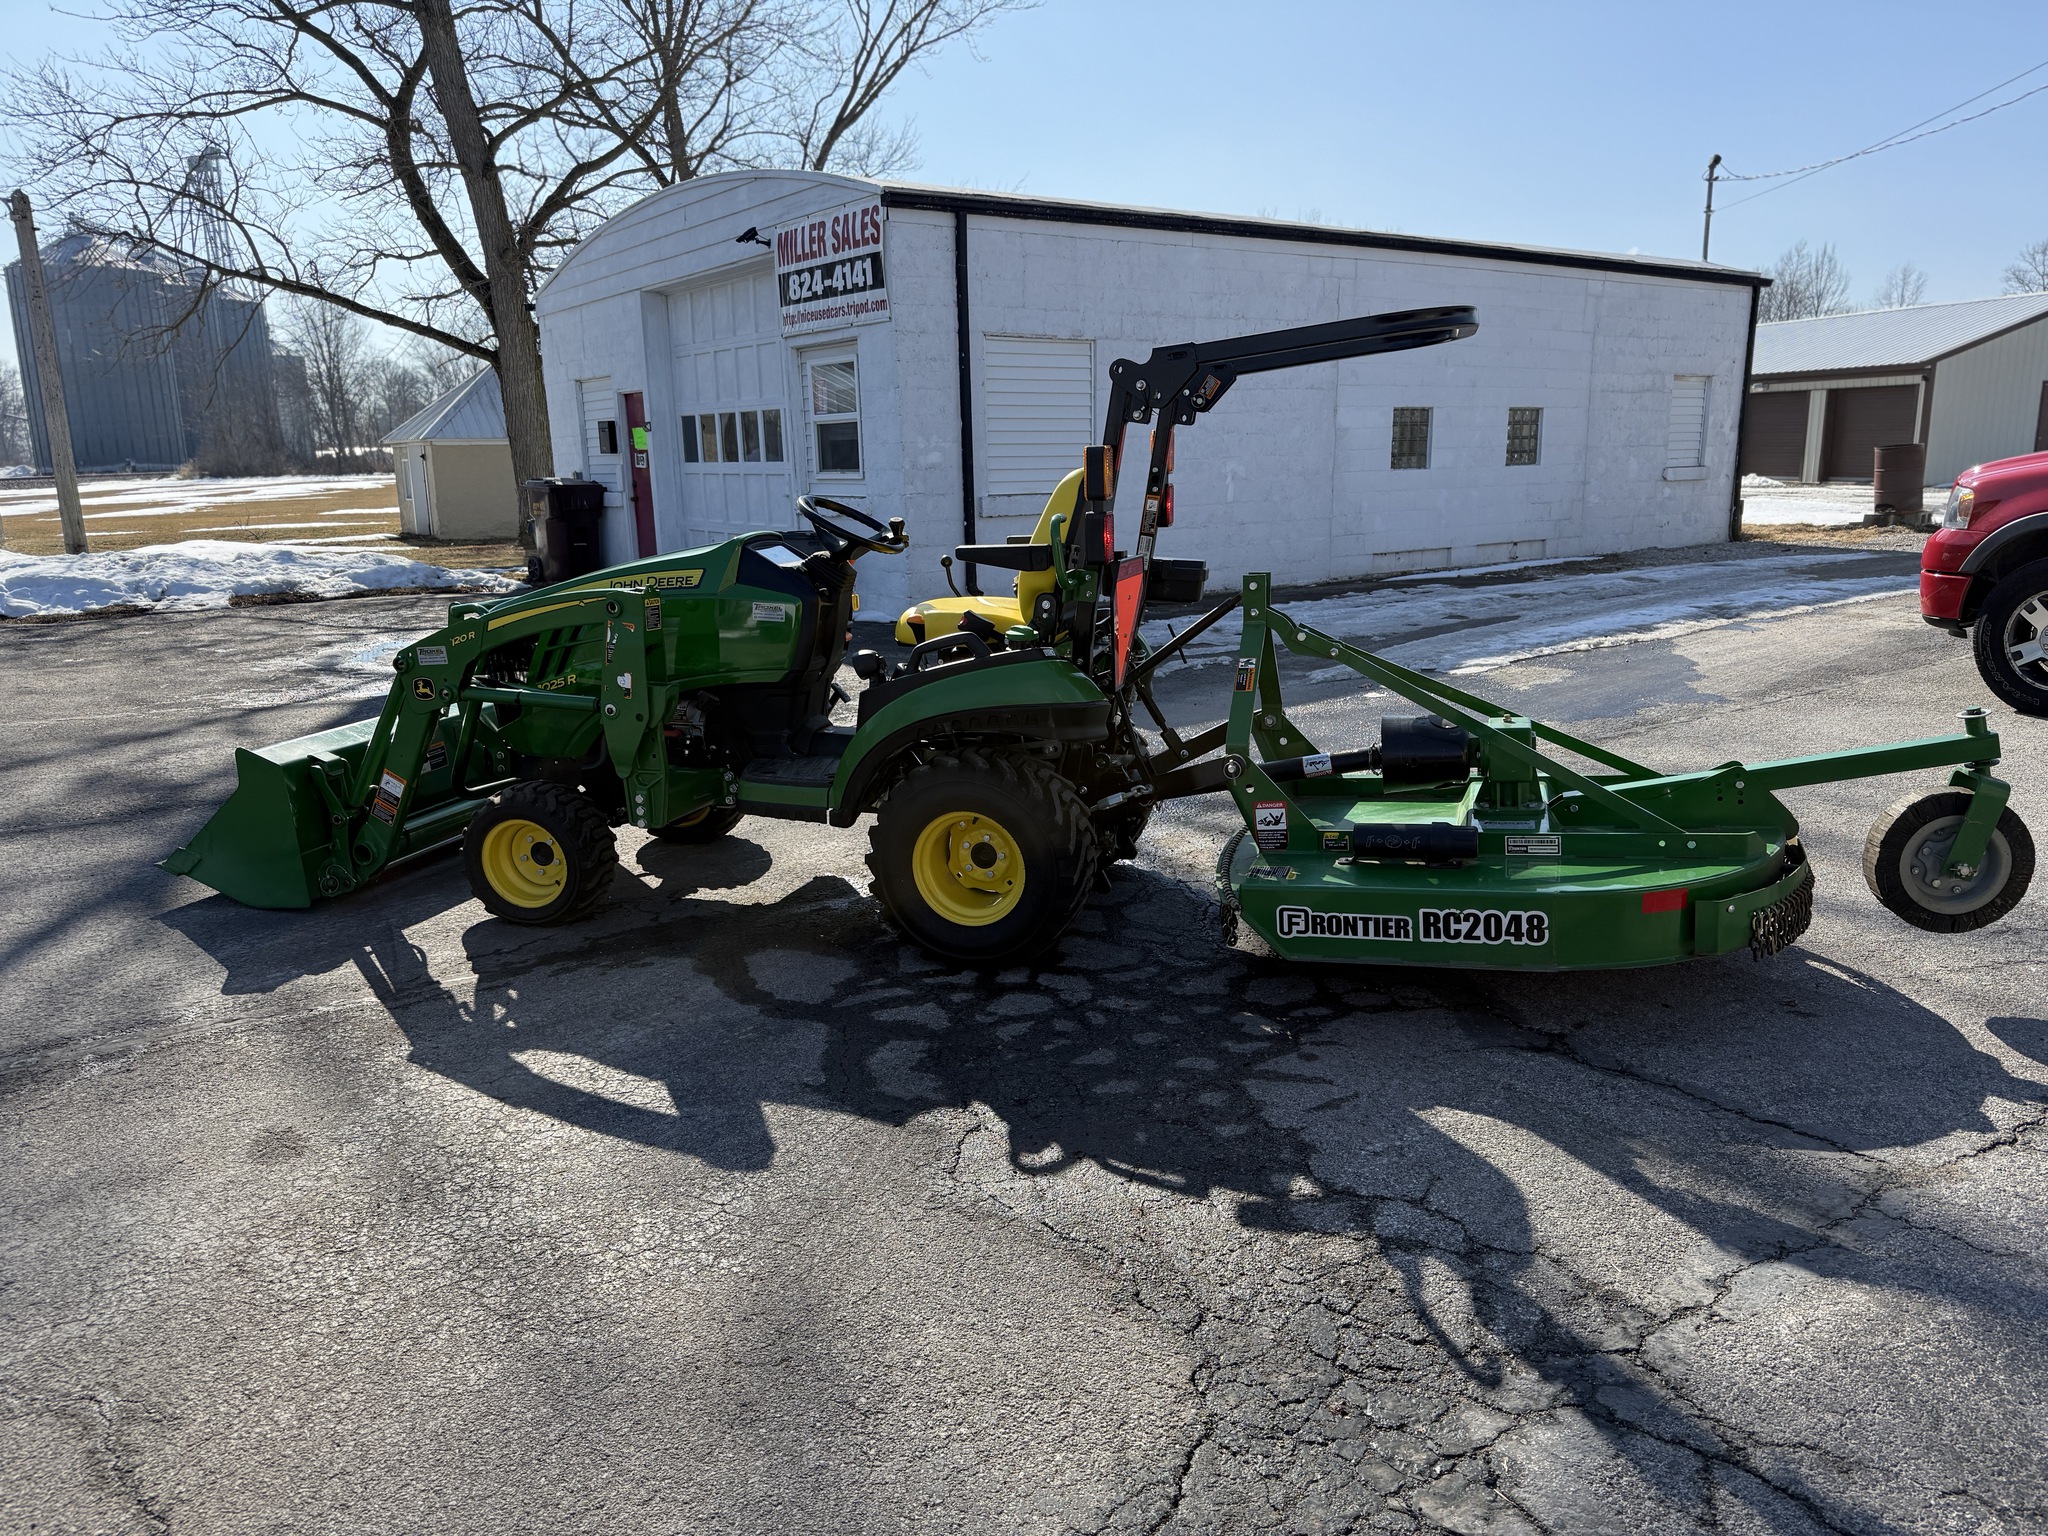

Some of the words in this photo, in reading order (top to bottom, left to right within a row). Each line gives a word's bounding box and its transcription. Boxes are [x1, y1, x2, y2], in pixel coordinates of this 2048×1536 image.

[777, 220, 827, 268] MILLER
[831, 204, 881, 255] SALES
[789, 257, 873, 300] 824-4141
[782, 298, 888, 328] http://niceusedcars.tripod.com
[646, 576, 694, 588] DEERE
[450, 634, 468, 647] 120
[468, 631, 476, 640] R
[567, 674, 577, 685] R
[1278, 906, 1412, 940] FRONTIER
[1421, 910, 1547, 944] RC2048
